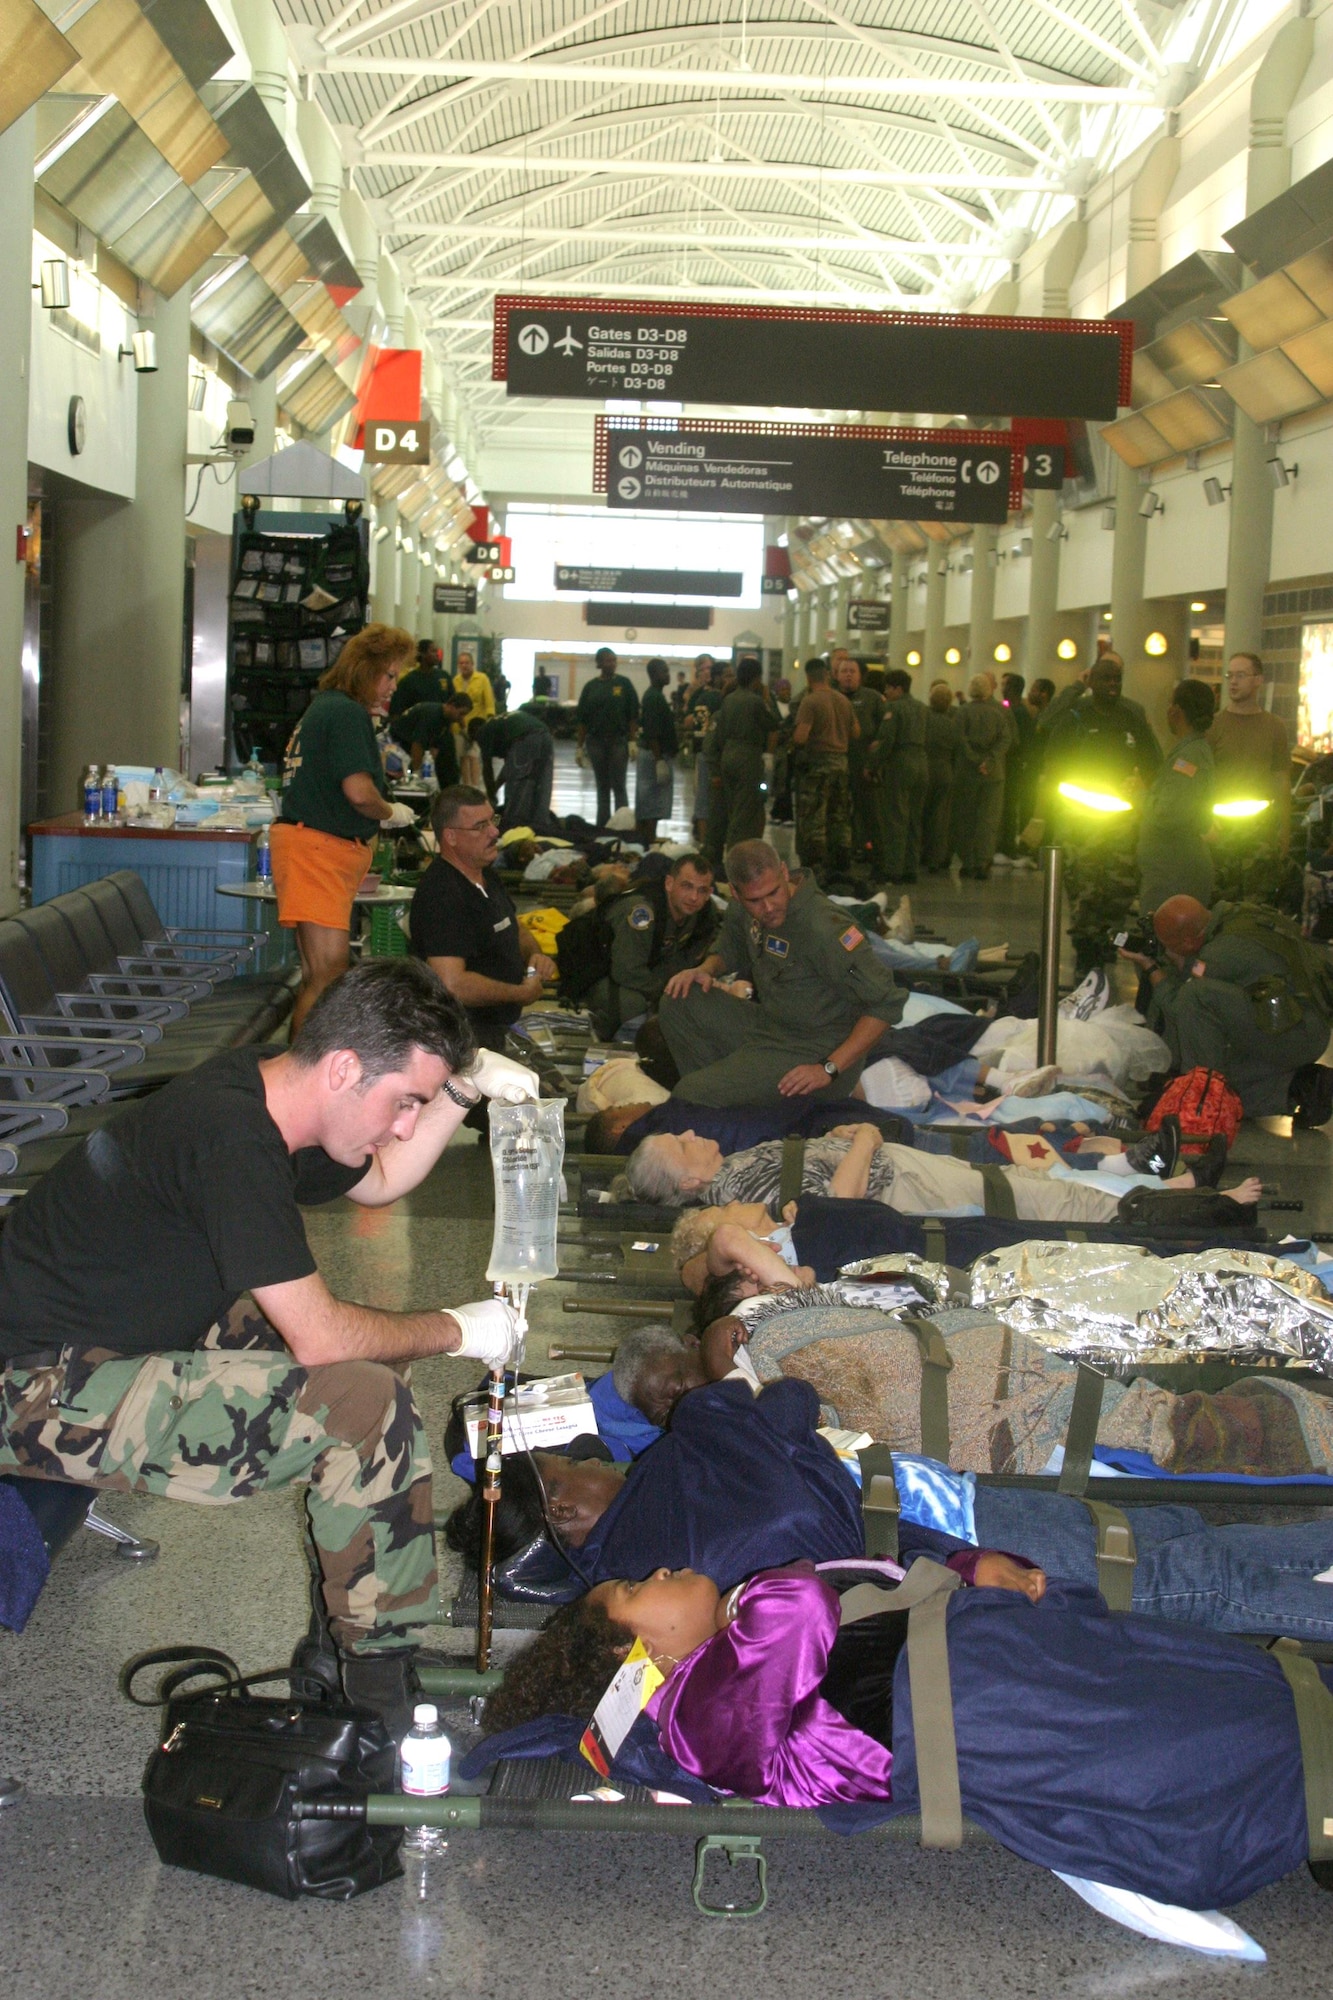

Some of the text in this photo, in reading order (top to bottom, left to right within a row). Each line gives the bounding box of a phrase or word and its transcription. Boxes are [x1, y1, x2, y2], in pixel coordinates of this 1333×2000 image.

[588, 326, 687, 342] Gates D3-D8
[587, 346, 678, 361] Salidas D3-D8
[587, 361, 673, 375] Portes D3-D8
[624, 378, 665, 390] D3-D8
[647, 440, 705, 458] Vending
[883, 450, 958, 467] Telephone
[645, 461, 768, 476] Máquinas Vendedoras
[645, 475, 793, 491] Distributeurs Automatique
[910, 472, 956, 484] Teléfono
[900, 485, 956, 498] Téléphone
